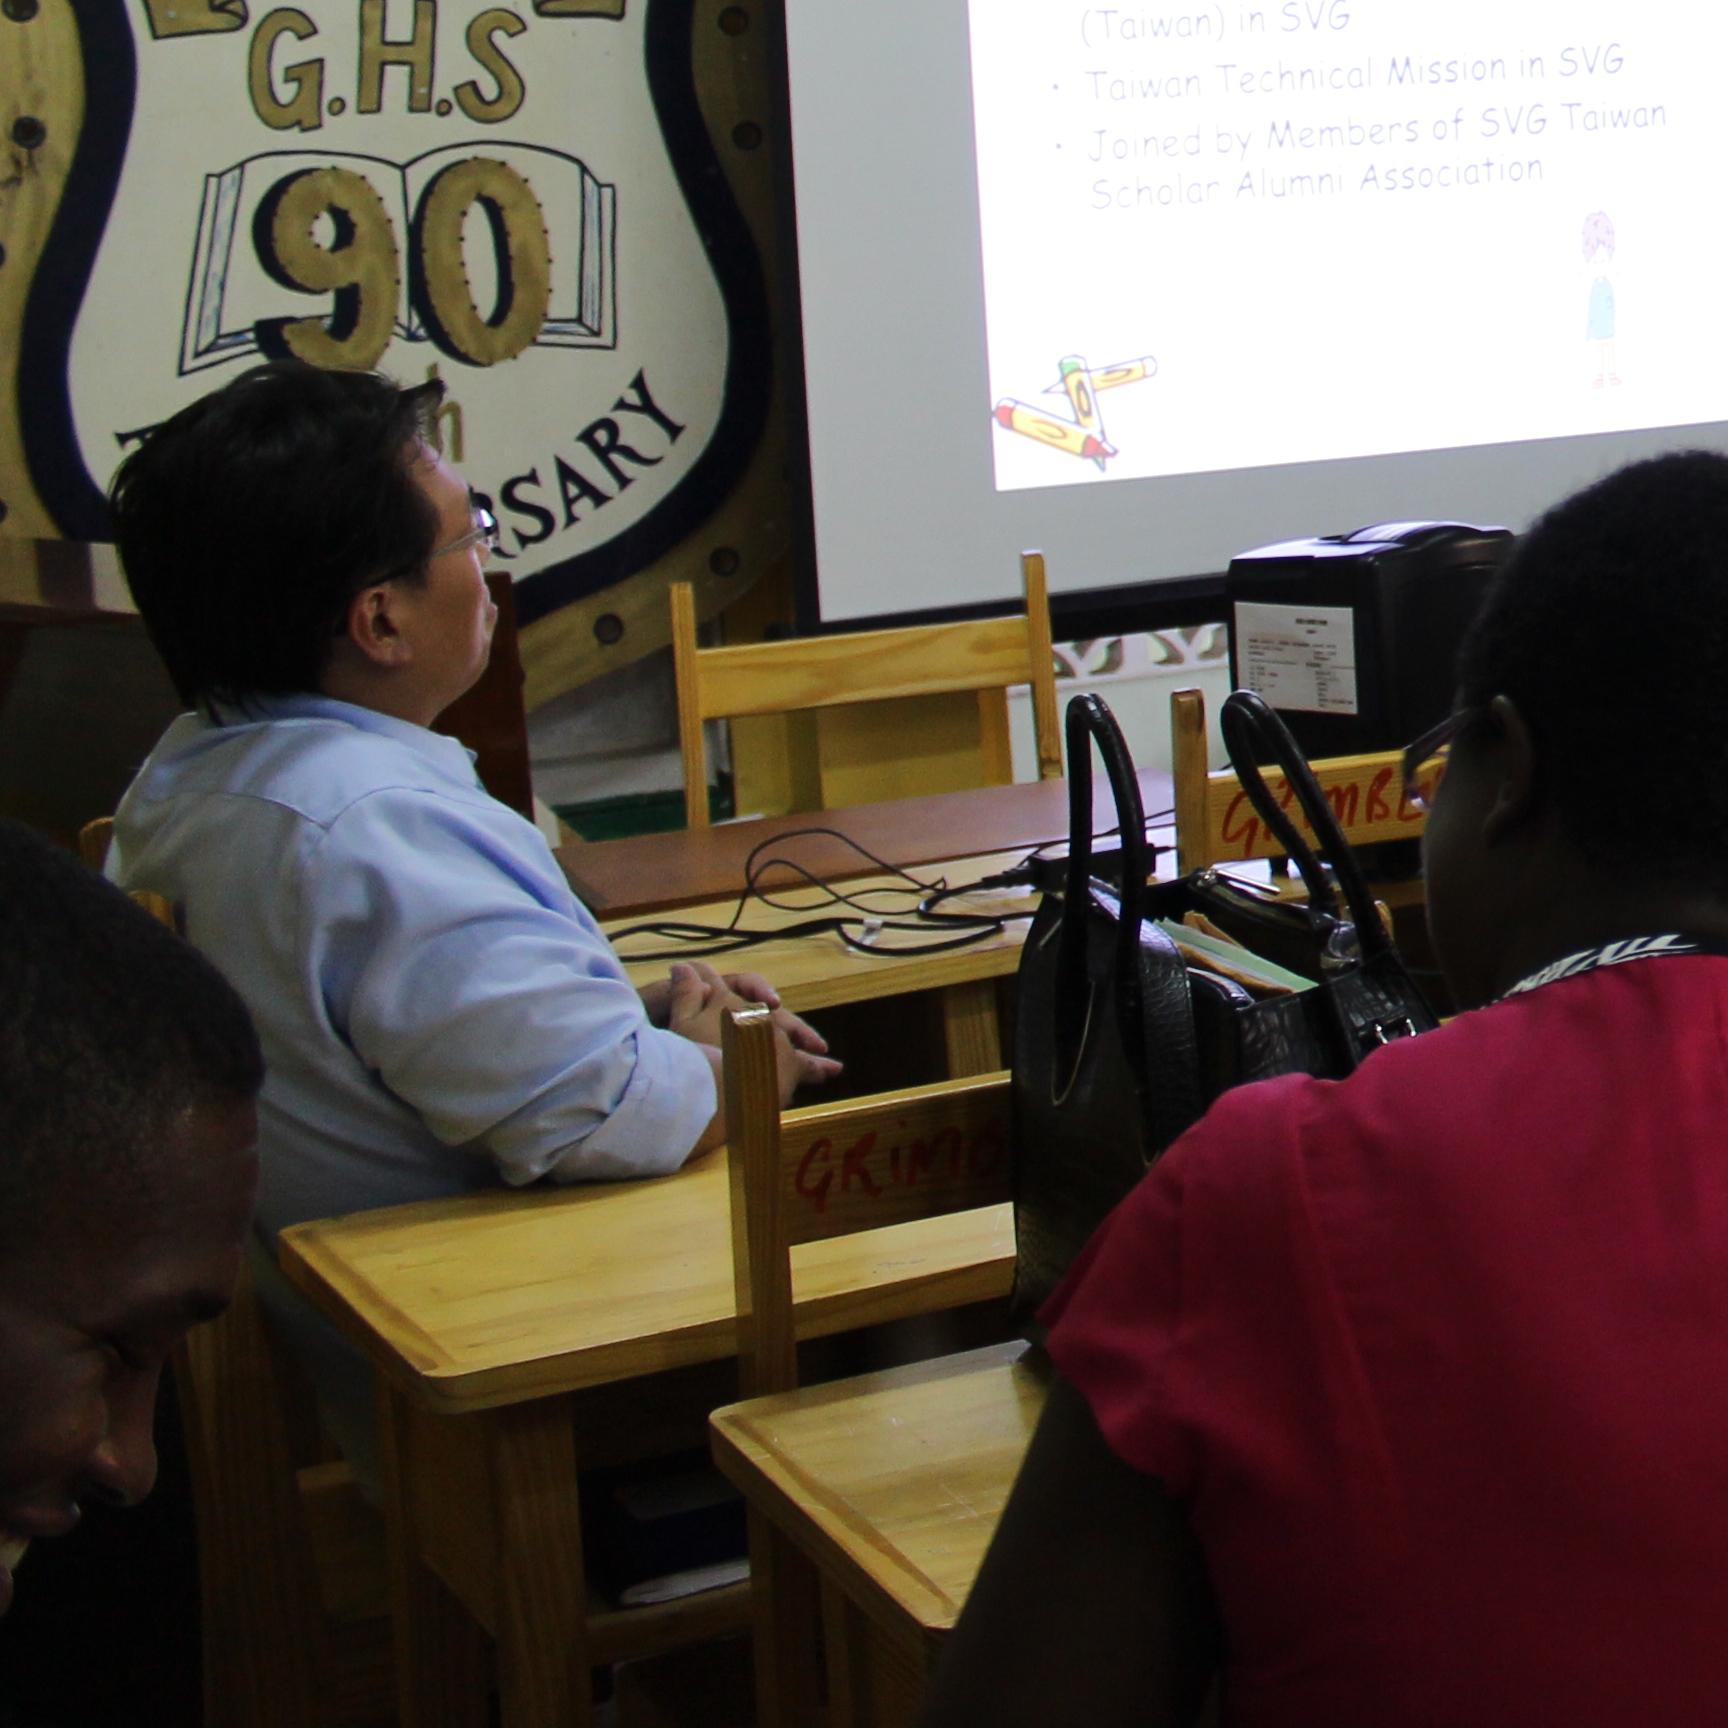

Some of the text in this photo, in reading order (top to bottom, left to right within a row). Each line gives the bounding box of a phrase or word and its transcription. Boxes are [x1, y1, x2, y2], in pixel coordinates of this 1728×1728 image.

[1079, 5, 1226, 49] (Taiwan)
[1239, 6, 1265, 33] in
[1085, 41, 1625, 102] Taiwan Technical Mission in SVG
[1087, 100, 1668, 163] Joined by Members of SVG Taiwan
[1091, 156, 1544, 210] Scholar Alumni Association
[252, 156, 553, 370] 90
